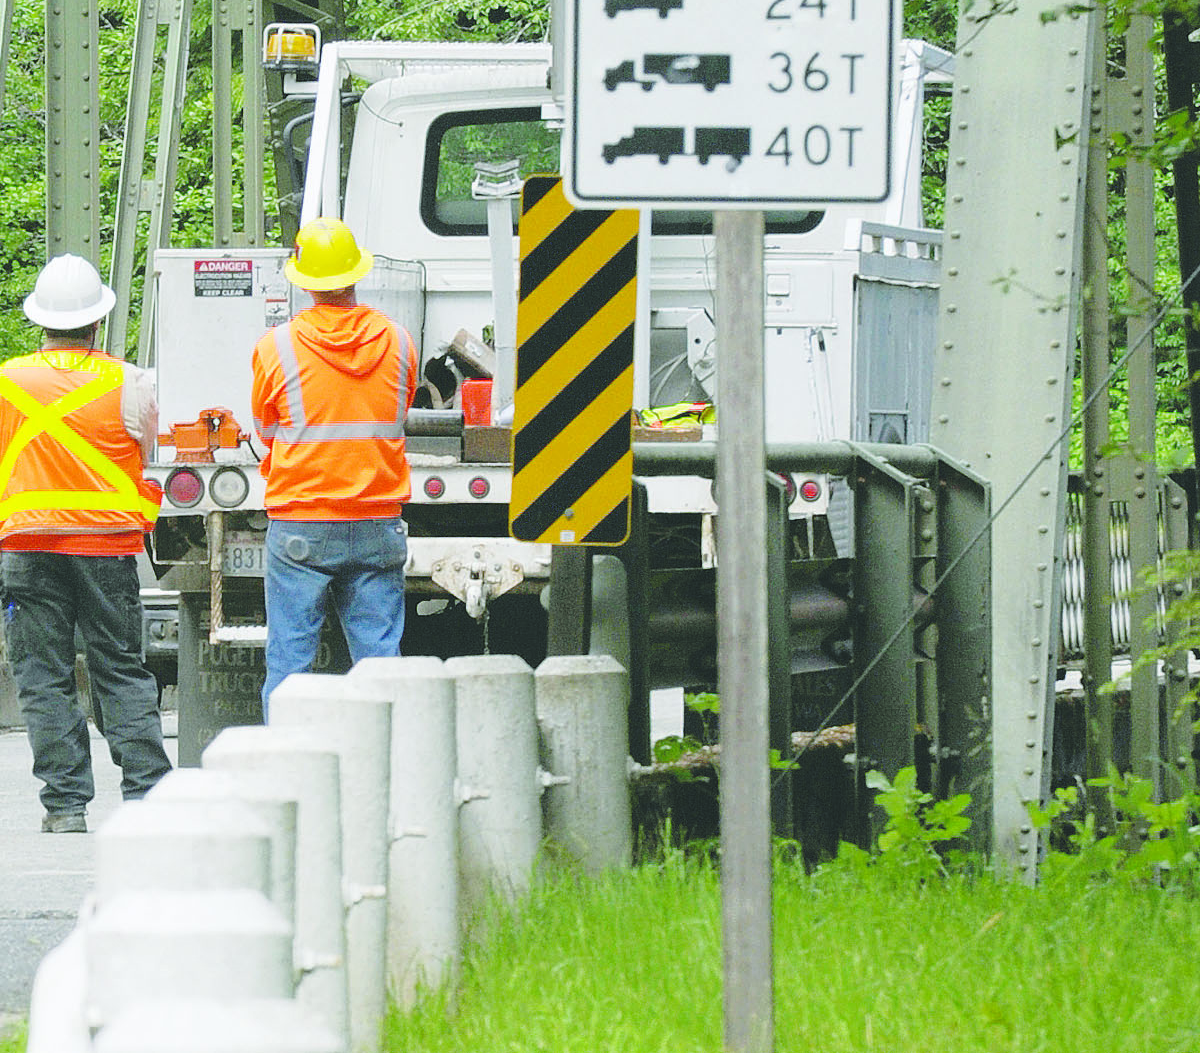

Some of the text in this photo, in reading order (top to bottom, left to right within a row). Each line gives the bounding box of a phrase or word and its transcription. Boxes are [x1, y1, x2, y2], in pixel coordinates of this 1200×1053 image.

[767, 51, 866, 94] 36T
[764, 124, 864, 168] 40T
[208, 262, 249, 272] DANGER
[233, 547, 263, 570] 831
